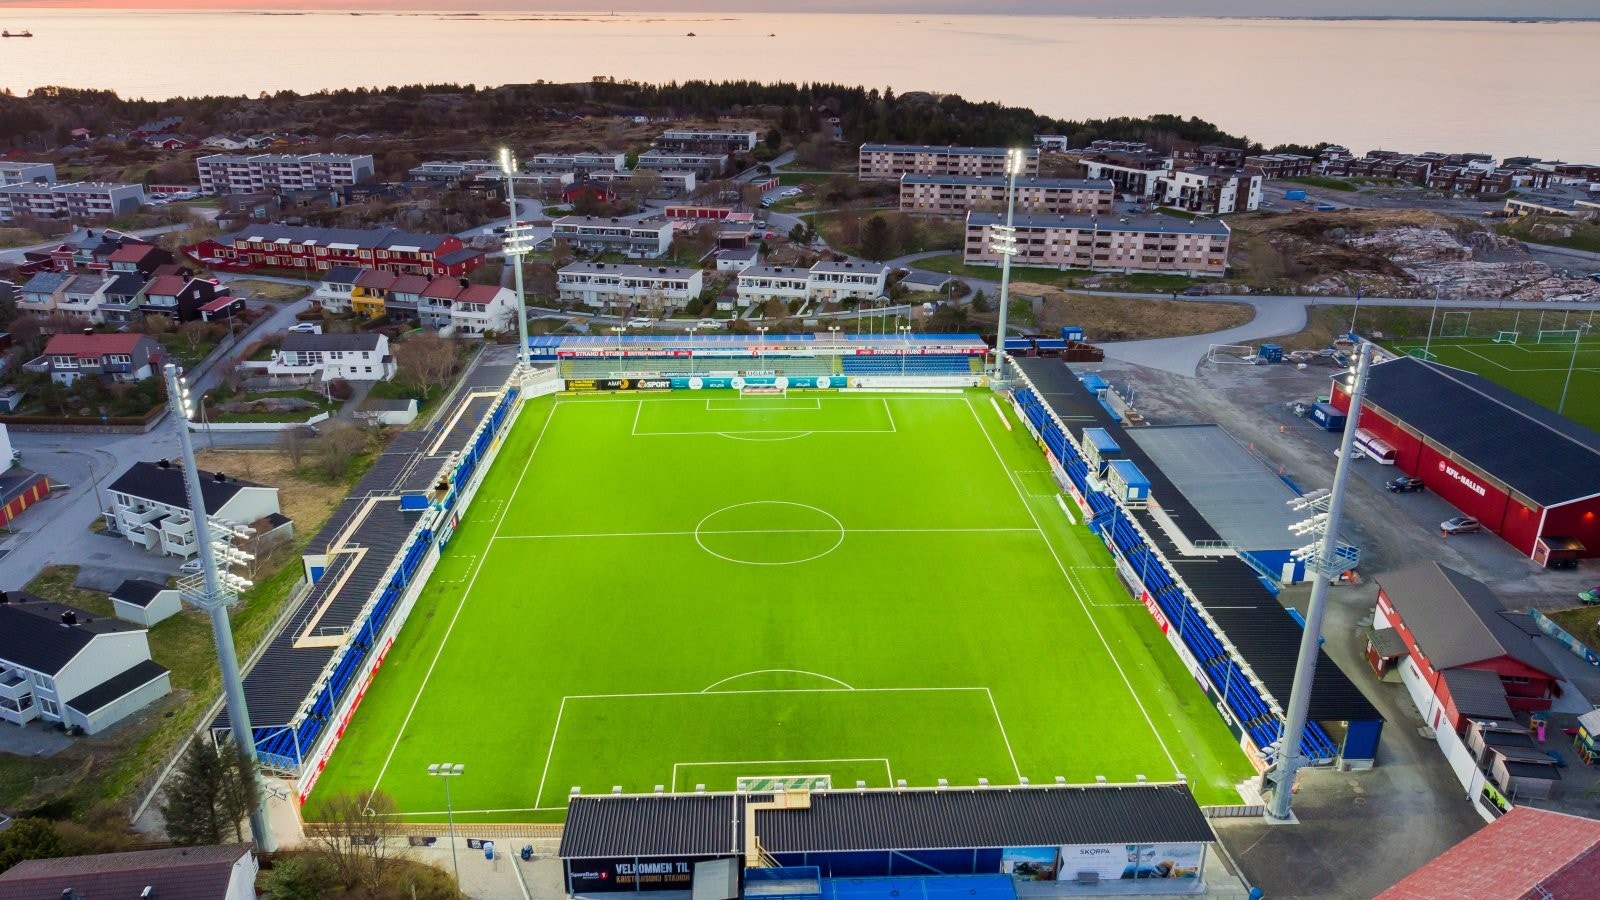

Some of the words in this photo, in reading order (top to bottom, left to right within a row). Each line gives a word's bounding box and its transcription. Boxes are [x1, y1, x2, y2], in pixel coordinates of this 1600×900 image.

[1446, 466, 1485, 496] KFK-HALLEN
[676, 862, 690, 873] TIL
[664, 873, 690, 882] STADION
